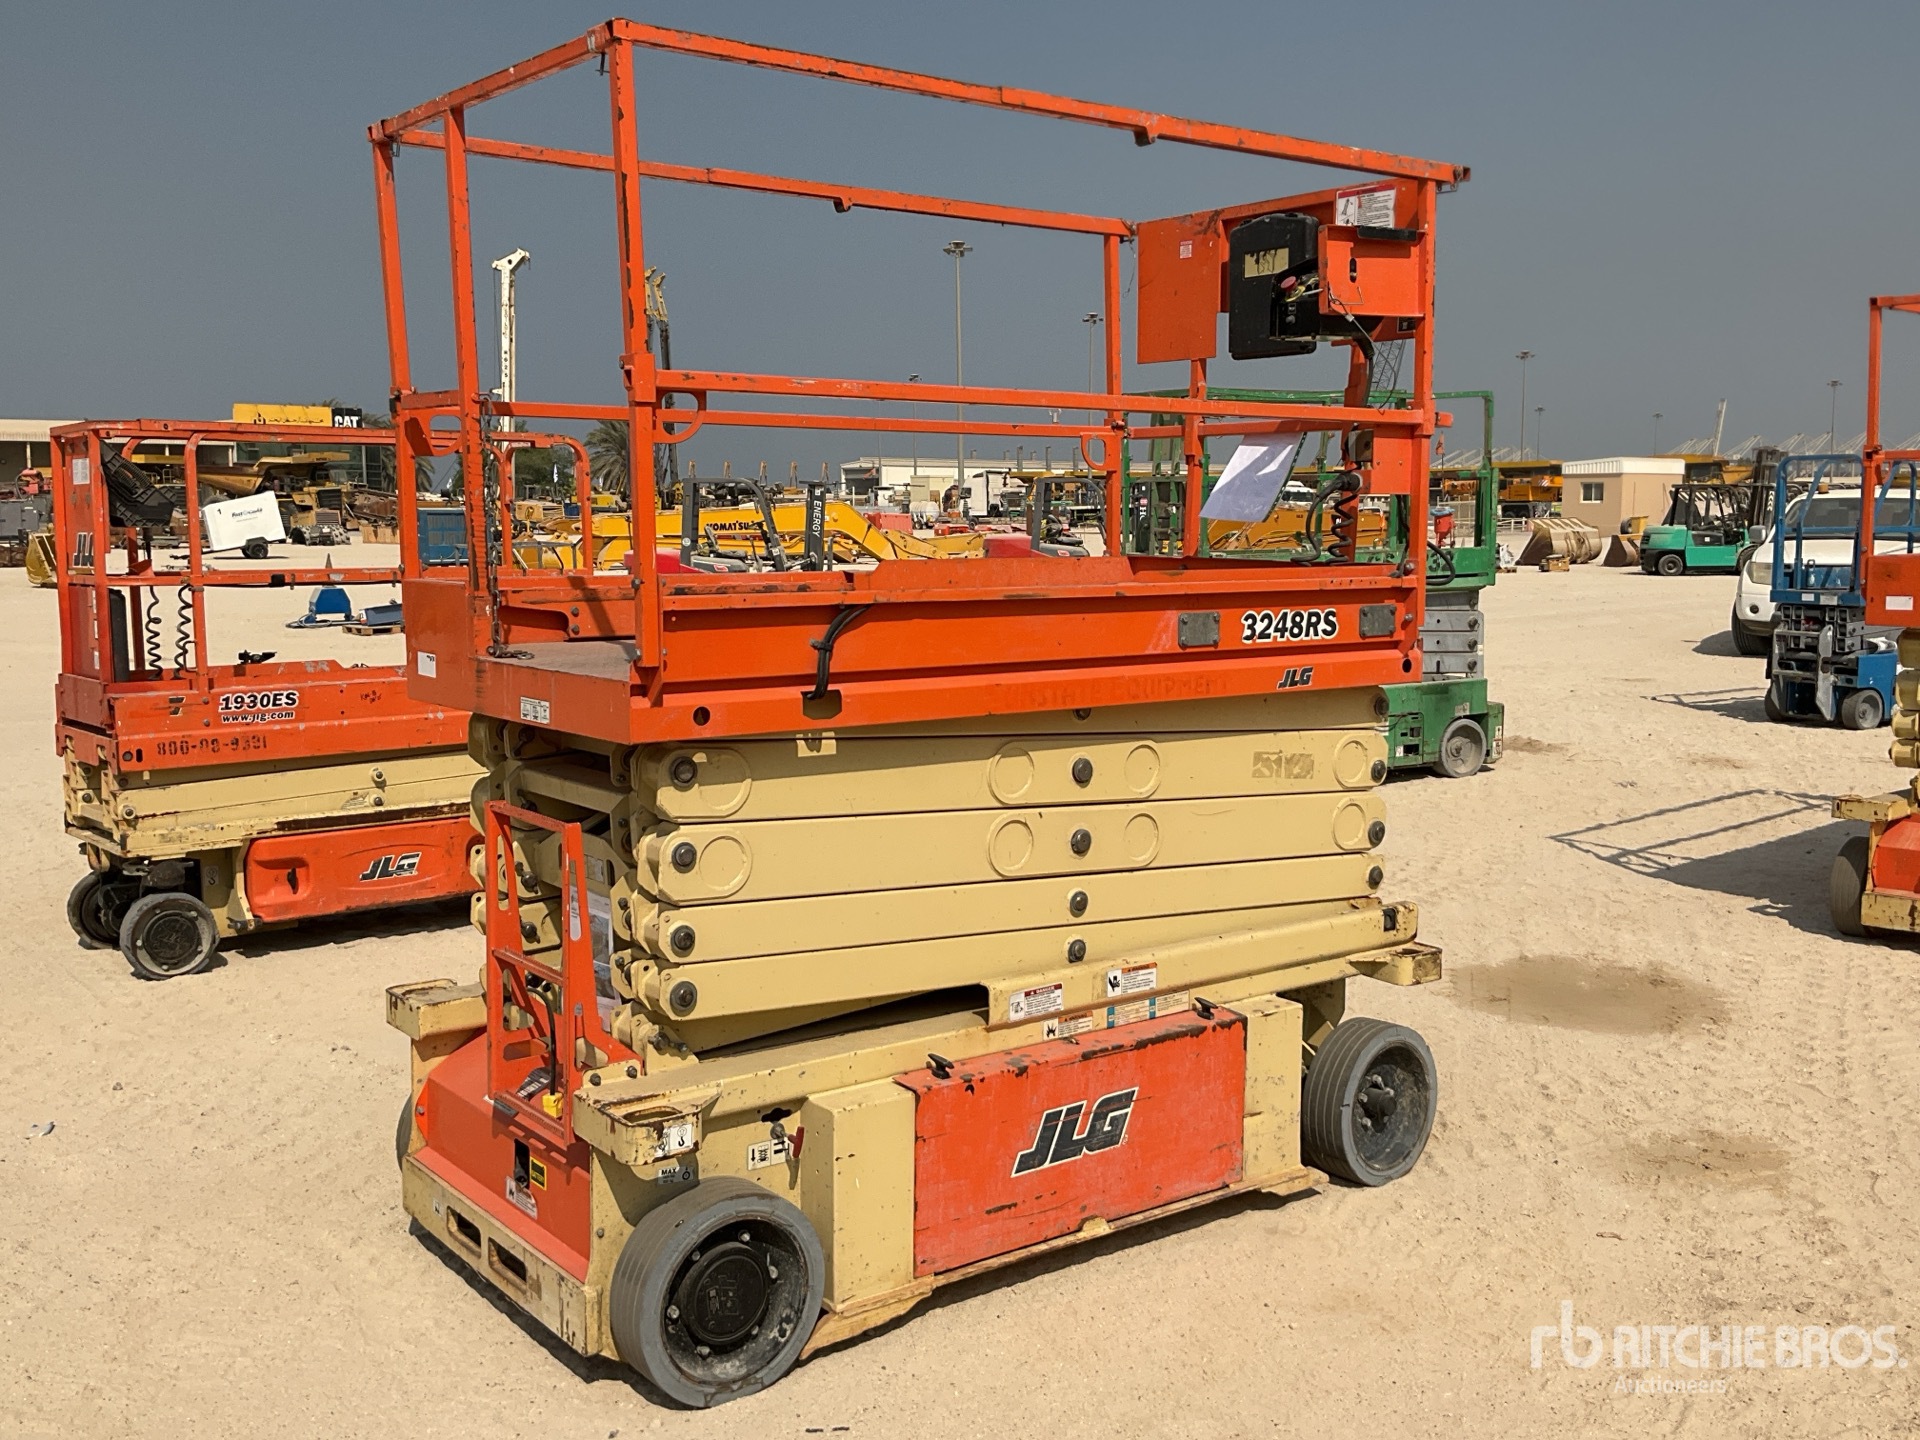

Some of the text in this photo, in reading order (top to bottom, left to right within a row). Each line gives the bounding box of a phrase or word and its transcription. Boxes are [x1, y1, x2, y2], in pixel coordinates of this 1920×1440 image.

[334, 415, 359, 428] CAT
[812, 500, 822, 538] ENERGY
[1242, 608, 1339, 643] 3248RS
[1277, 667, 1313, 689] JLG
[219, 690, 299, 712] 1930ES
[360, 851, 422, 882] JLG
[1010, 1086, 1139, 1178] JLG
[661, 1167, 677, 1175] MAX
